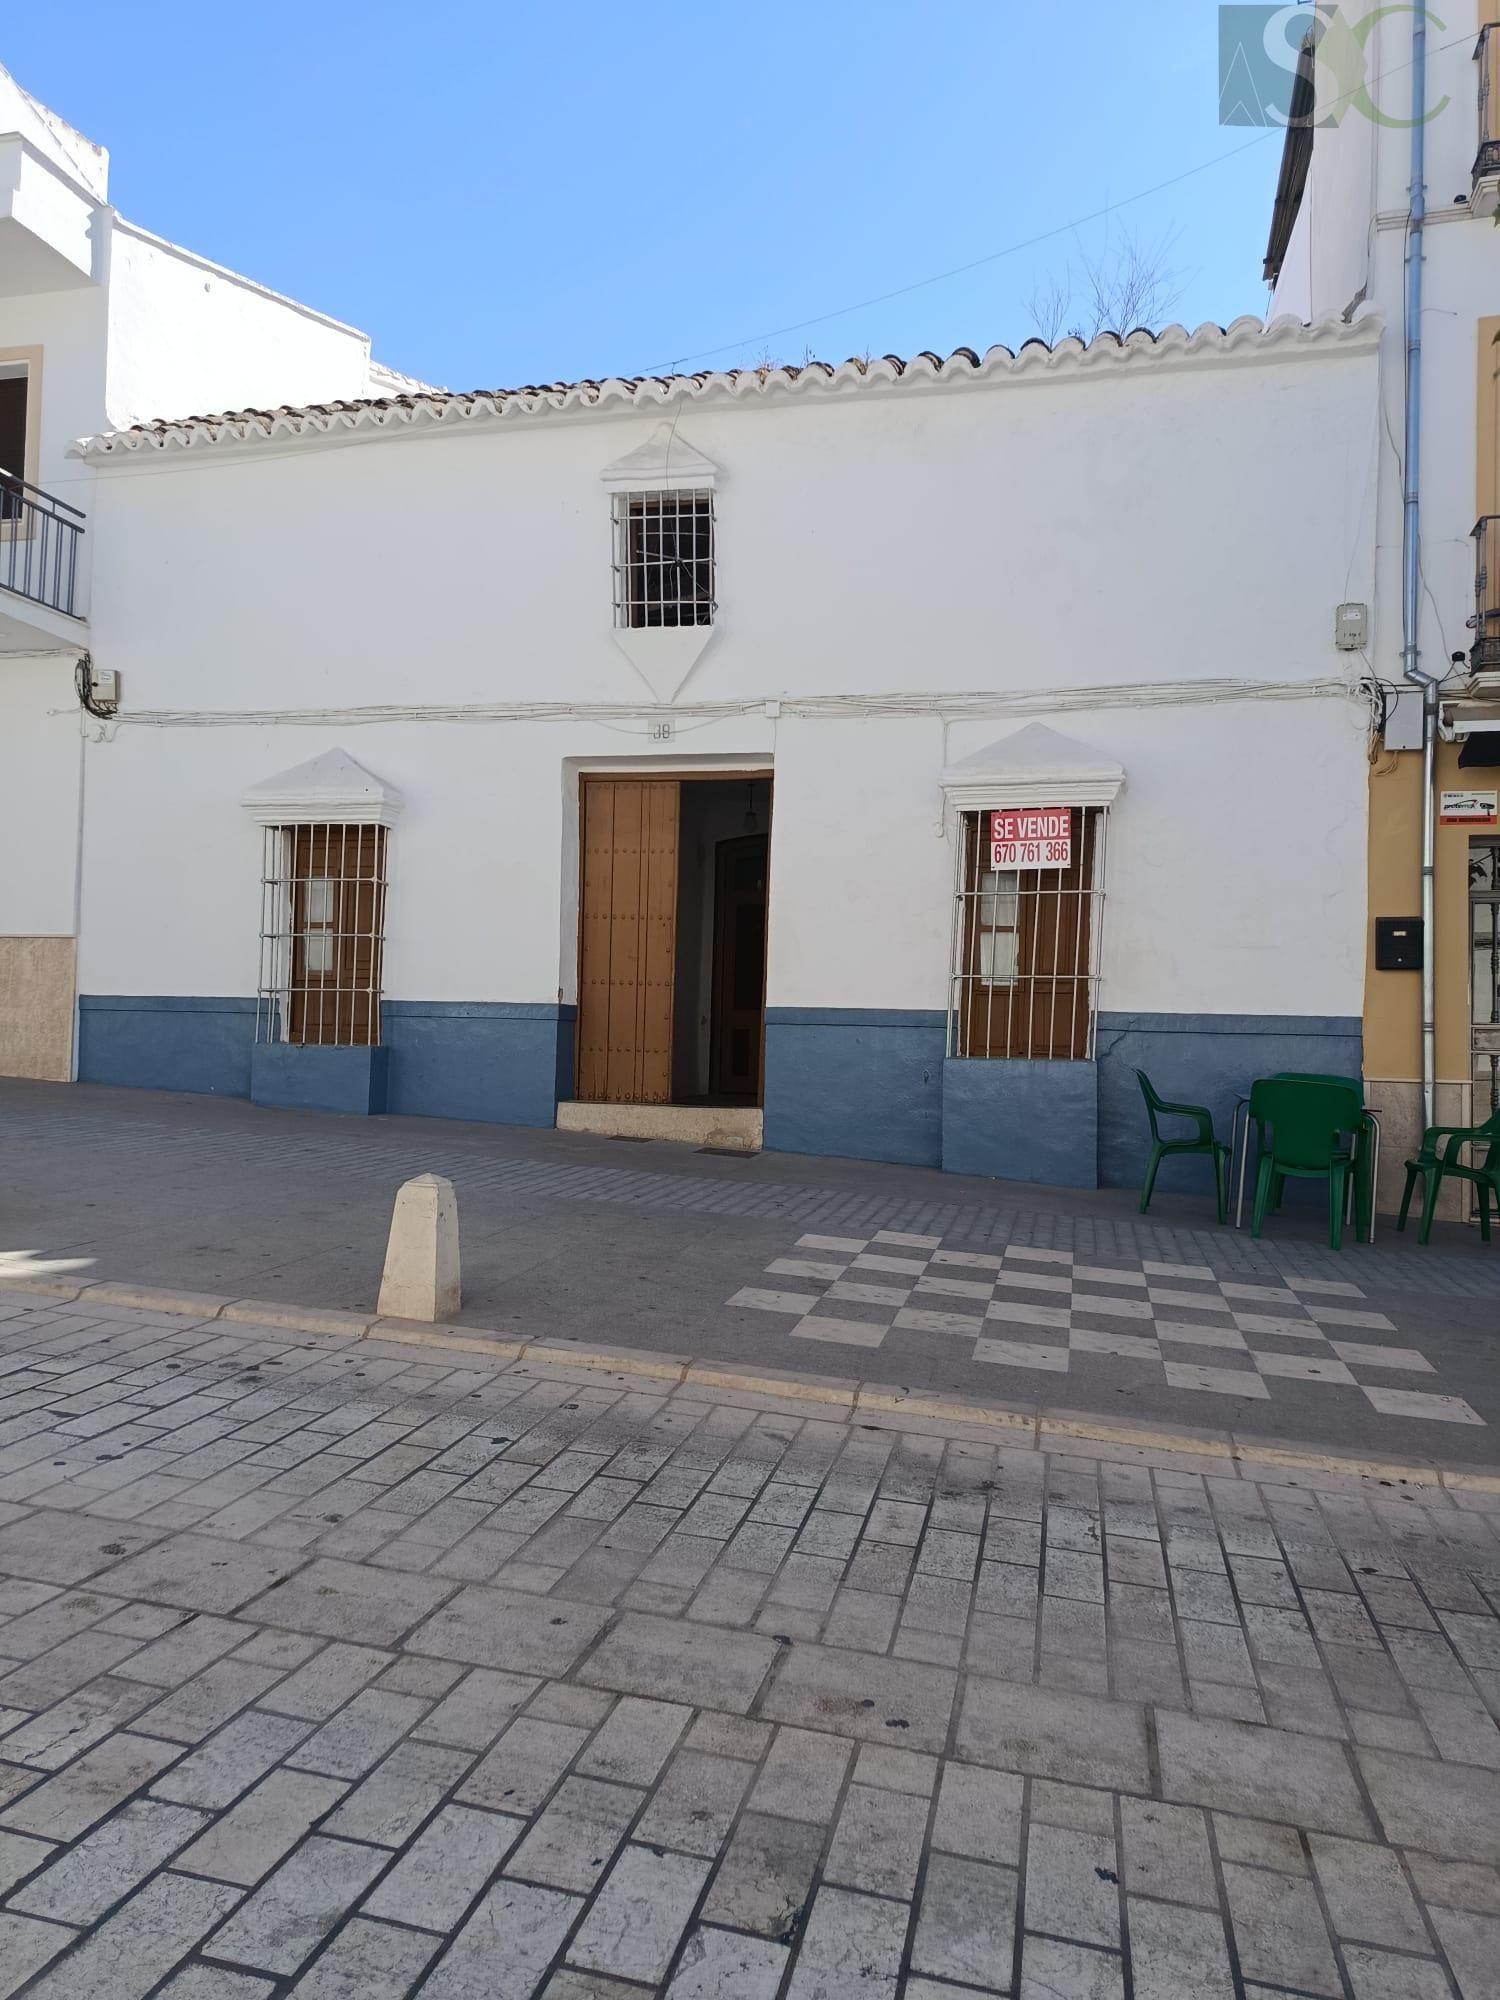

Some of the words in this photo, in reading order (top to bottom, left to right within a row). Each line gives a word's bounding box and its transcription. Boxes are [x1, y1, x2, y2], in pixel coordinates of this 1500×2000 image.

[994, 818, 1014, 839] SE
[1017, 815, 1069, 838] VENDE
[994, 843, 1016, 864] 670
[1020, 842, 1041, 863] 761
[1046, 841, 1068, 862] 366
